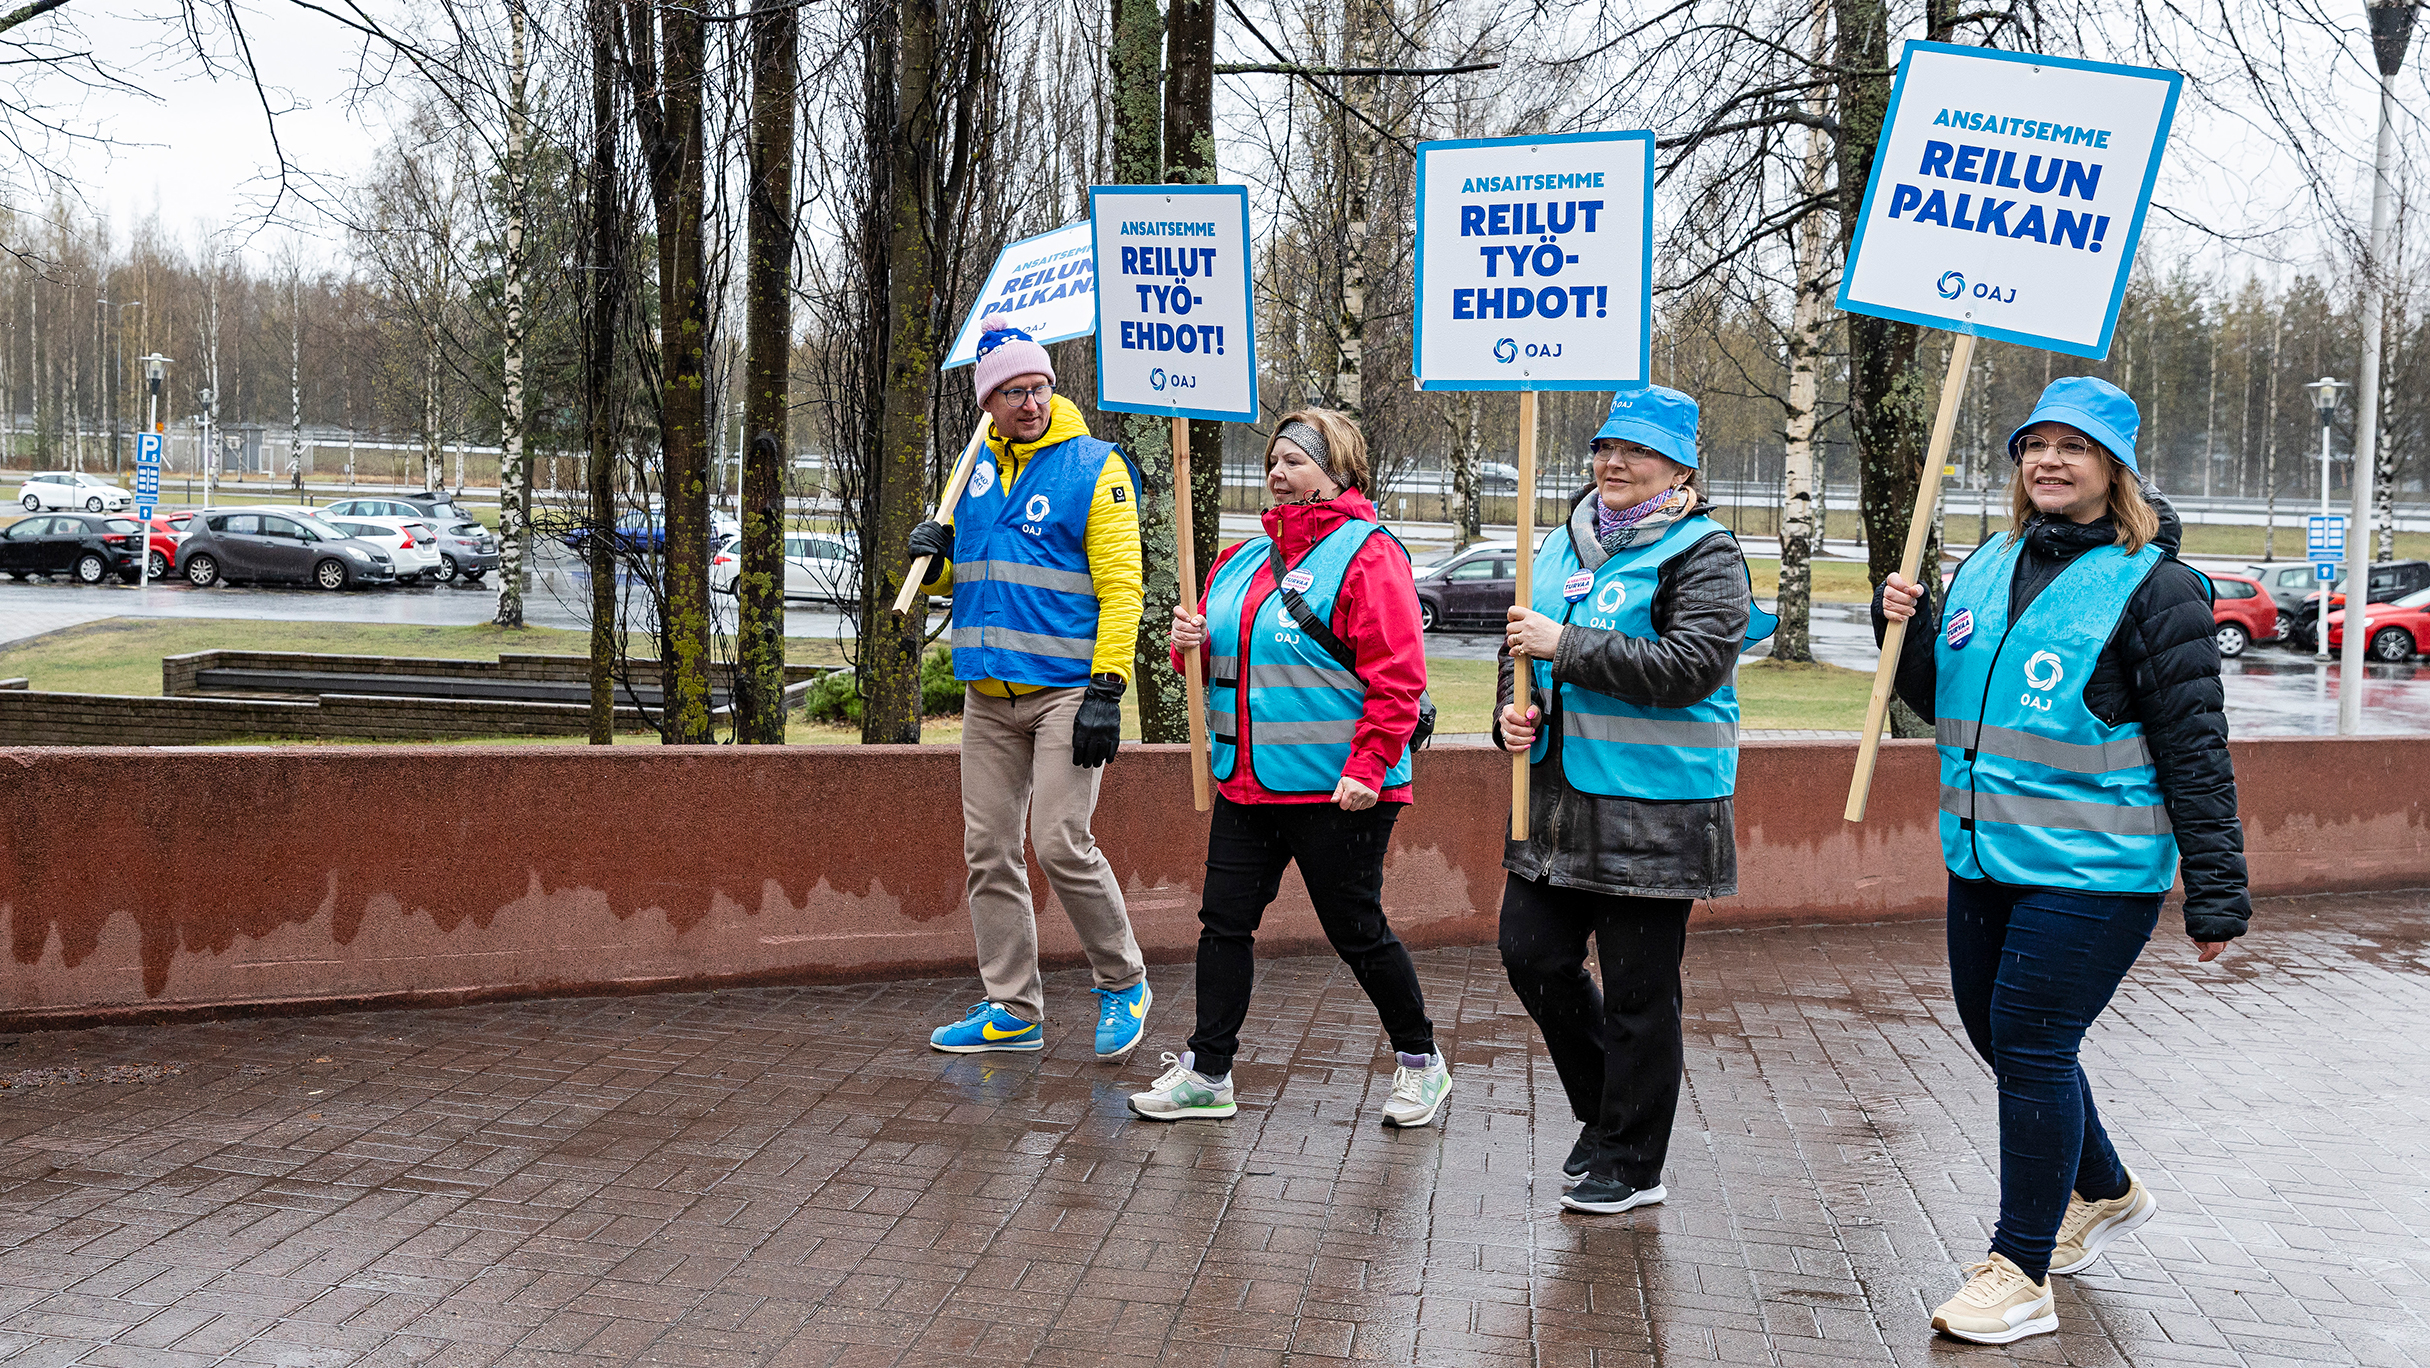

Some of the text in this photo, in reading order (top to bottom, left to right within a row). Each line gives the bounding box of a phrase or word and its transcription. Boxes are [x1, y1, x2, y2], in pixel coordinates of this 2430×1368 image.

[1932, 108, 2112, 150] ANSAITSEMME
[1461, 172, 1605, 194] ANSAITSEMME
[1919, 139, 2103, 201] REILUN
[1120, 221, 1216, 237] ANSAITSEMME
[1460, 200, 1604, 237] REILUT
[1888, 183, 2111, 254] PALKAN!
[1121, 246, 1217, 278] REILUT
[1480, 235, 1579, 278] TYÖ-
[1136, 277, 1203, 315] TYÖ-
[1452, 286, 1608, 320] EHDOT!
[1972, 282, 2017, 304] OAJ
[1120, 321, 1225, 356] EHDOT!
[1524, 343, 1562, 358] OAJ
[1171, 375, 1196, 389] OAJ
[142, 435, 159, 461] P
[1022, 523, 1042, 536] OAJ
[1590, 617, 1616, 630] OAJ
[1274, 632, 1300, 644] OAJ
[2020, 693, 2052, 711] OAJ
